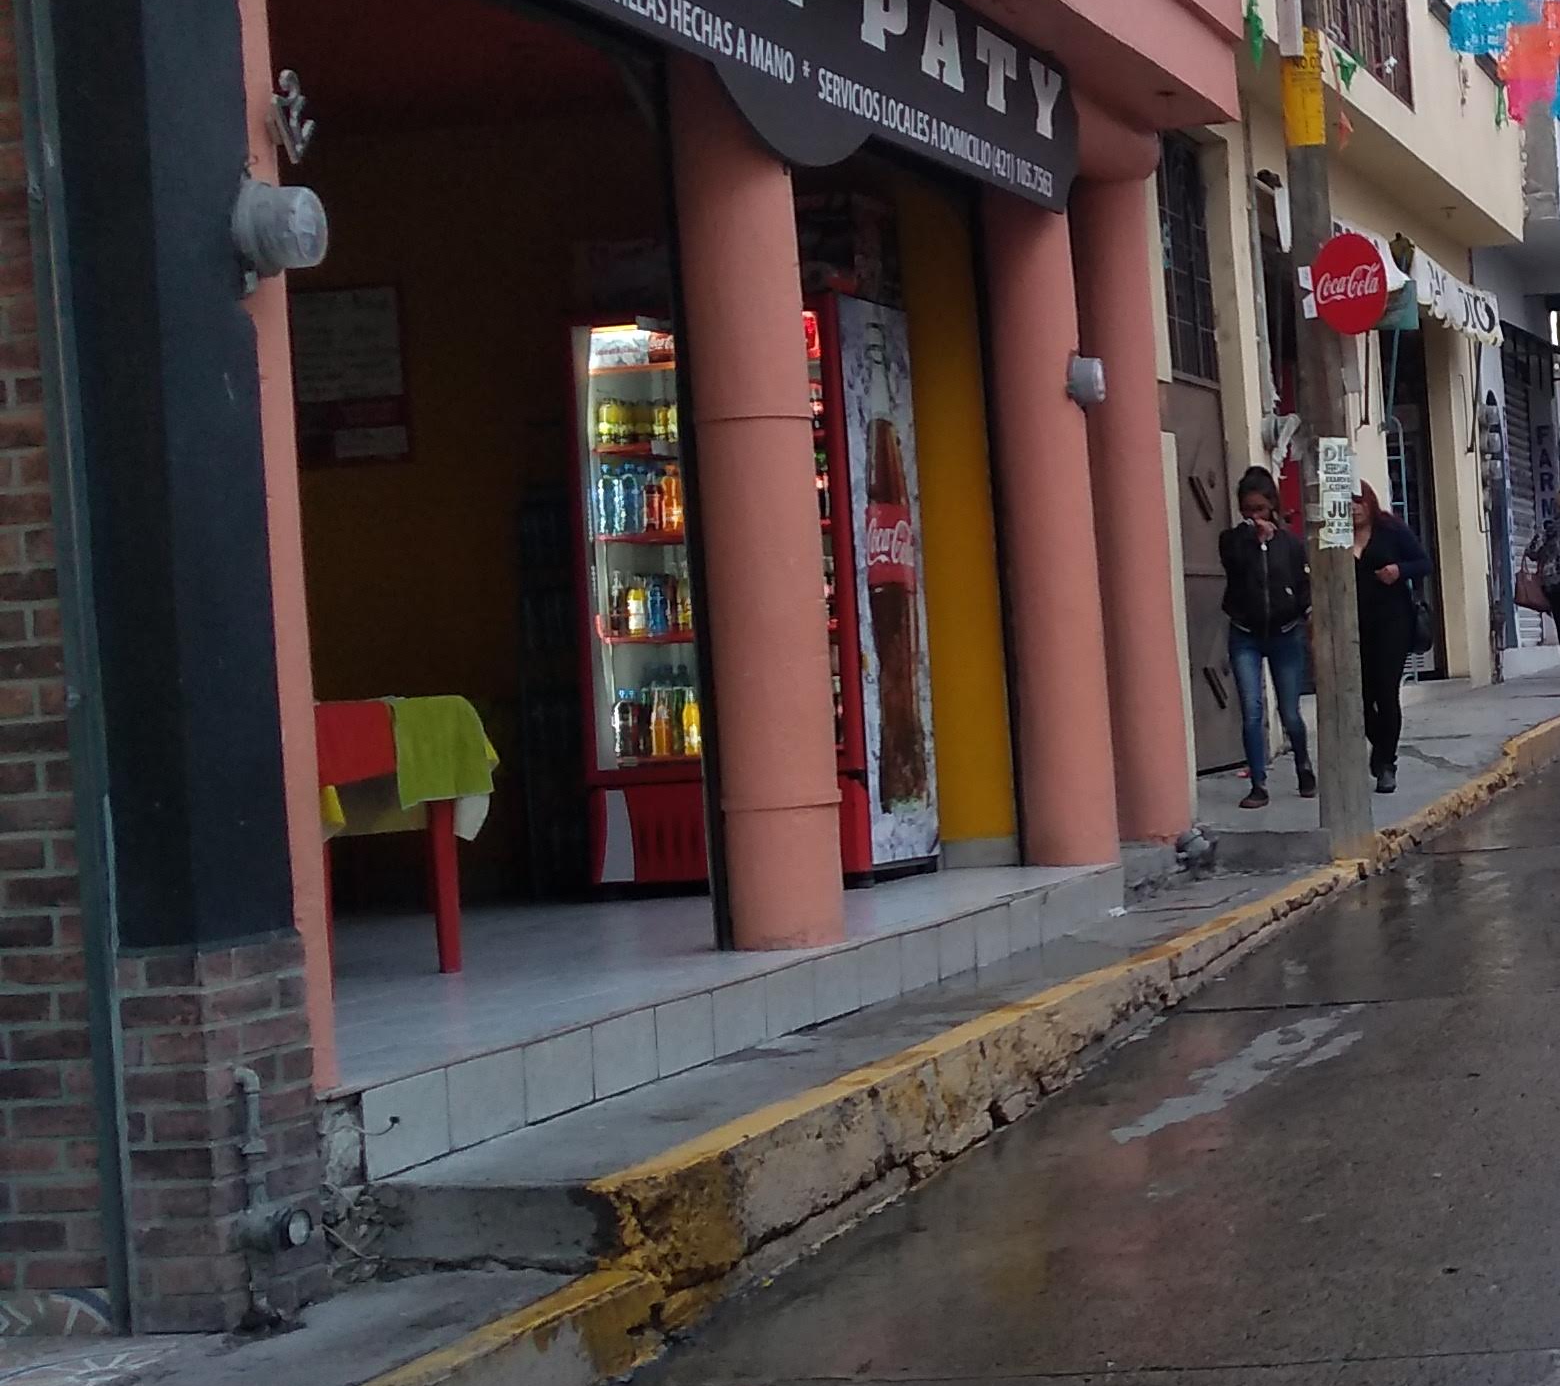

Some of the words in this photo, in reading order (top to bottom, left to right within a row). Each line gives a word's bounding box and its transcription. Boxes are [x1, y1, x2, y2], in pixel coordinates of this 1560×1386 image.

[735, 26, 748, 63] A
[750, 33, 795, 84] MANO
[818, 67, 880, 123] SERVICIOS
[881, 95, 930, 144] LOCALES
[930, 118, 939, 148] A
[940, 121, 992, 170] DOMICILIO
